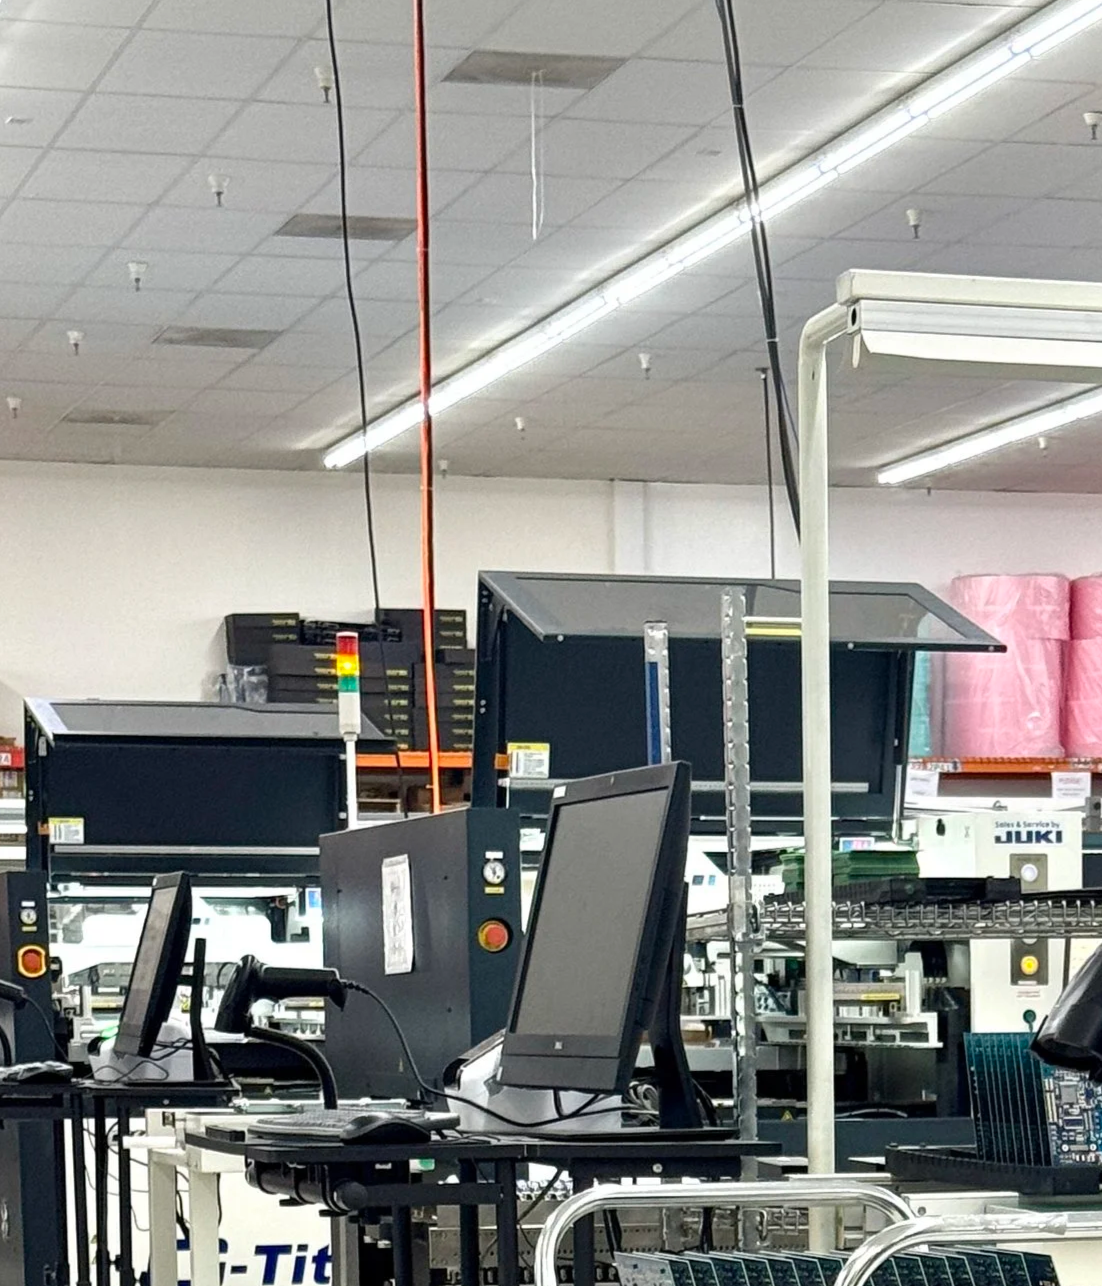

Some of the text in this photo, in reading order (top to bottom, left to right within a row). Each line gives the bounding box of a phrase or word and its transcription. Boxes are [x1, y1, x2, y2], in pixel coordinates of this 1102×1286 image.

[1023, 820, 1050, 828] Service
[1051, 820, 1060, 829] by
[994, 830, 1063, 844] JUKI
